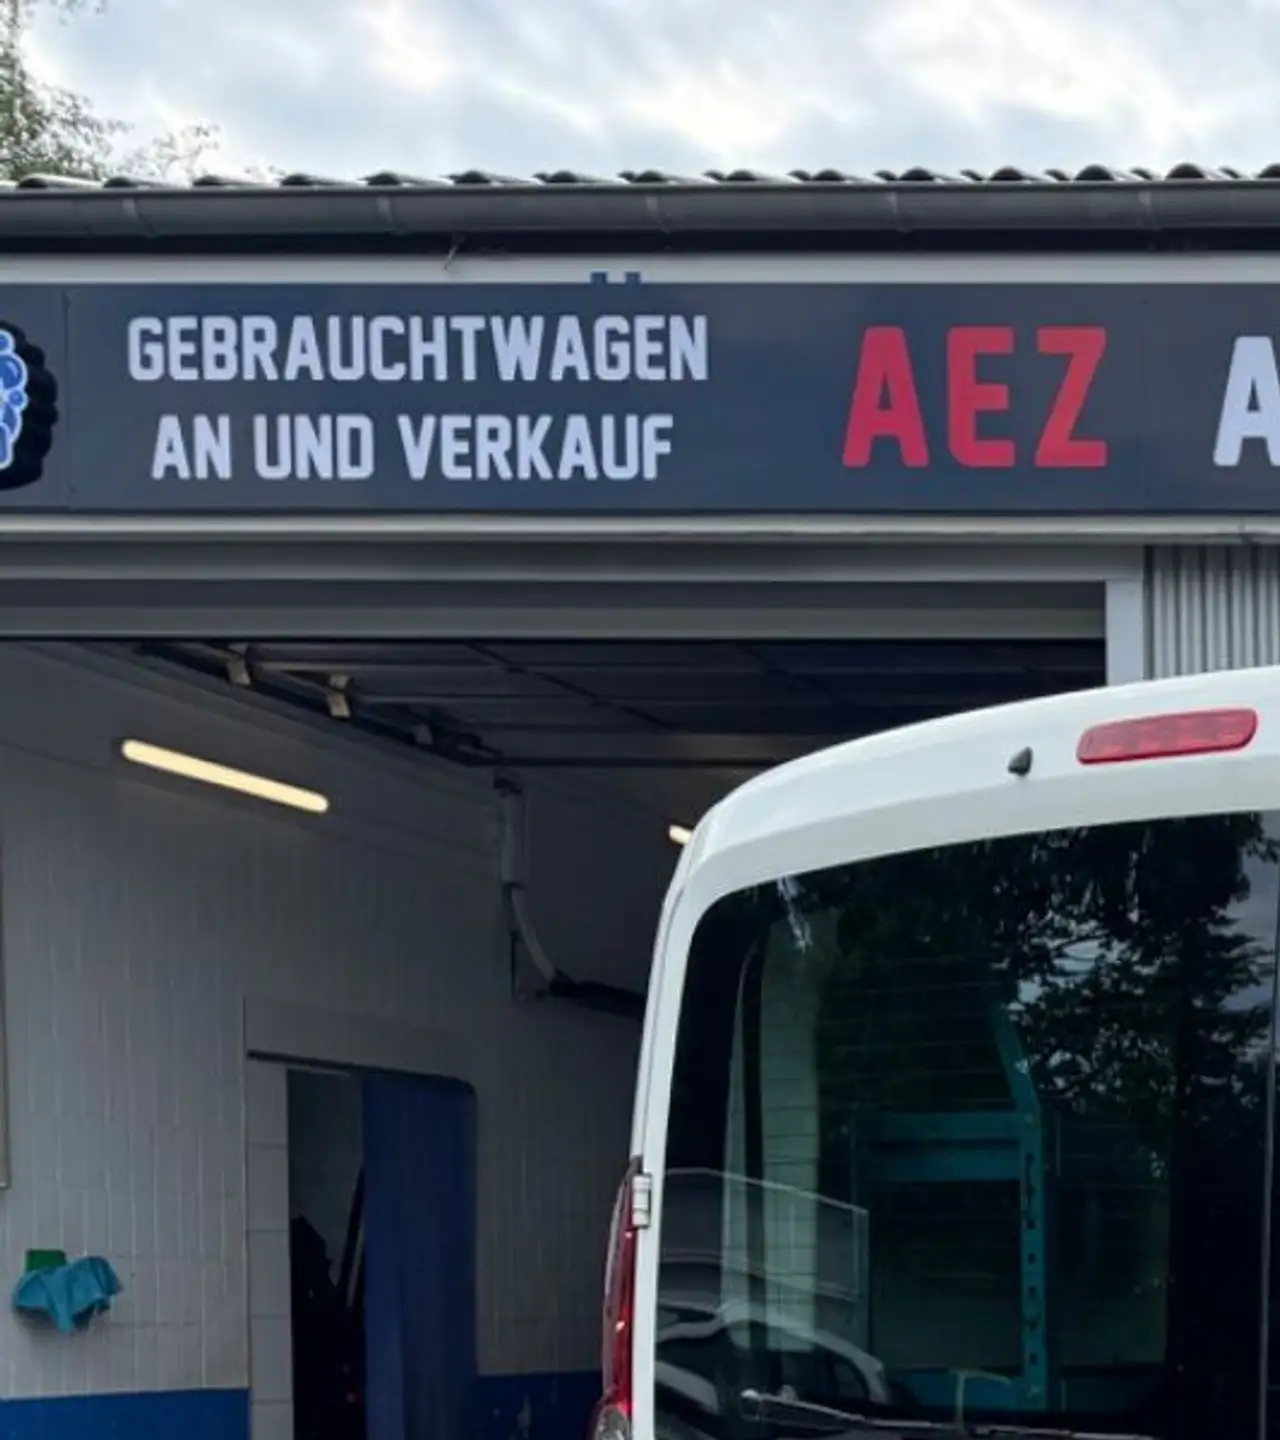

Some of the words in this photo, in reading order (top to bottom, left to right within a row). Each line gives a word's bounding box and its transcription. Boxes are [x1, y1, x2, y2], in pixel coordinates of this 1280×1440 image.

[127, 315, 708, 382] GEBRAUCHTWAGEN
[841, 326, 1109, 468] AEZ
[151, 414, 231, 480] AN
[253, 414, 374, 480] UND
[398, 413, 674, 481] VERKAUF
